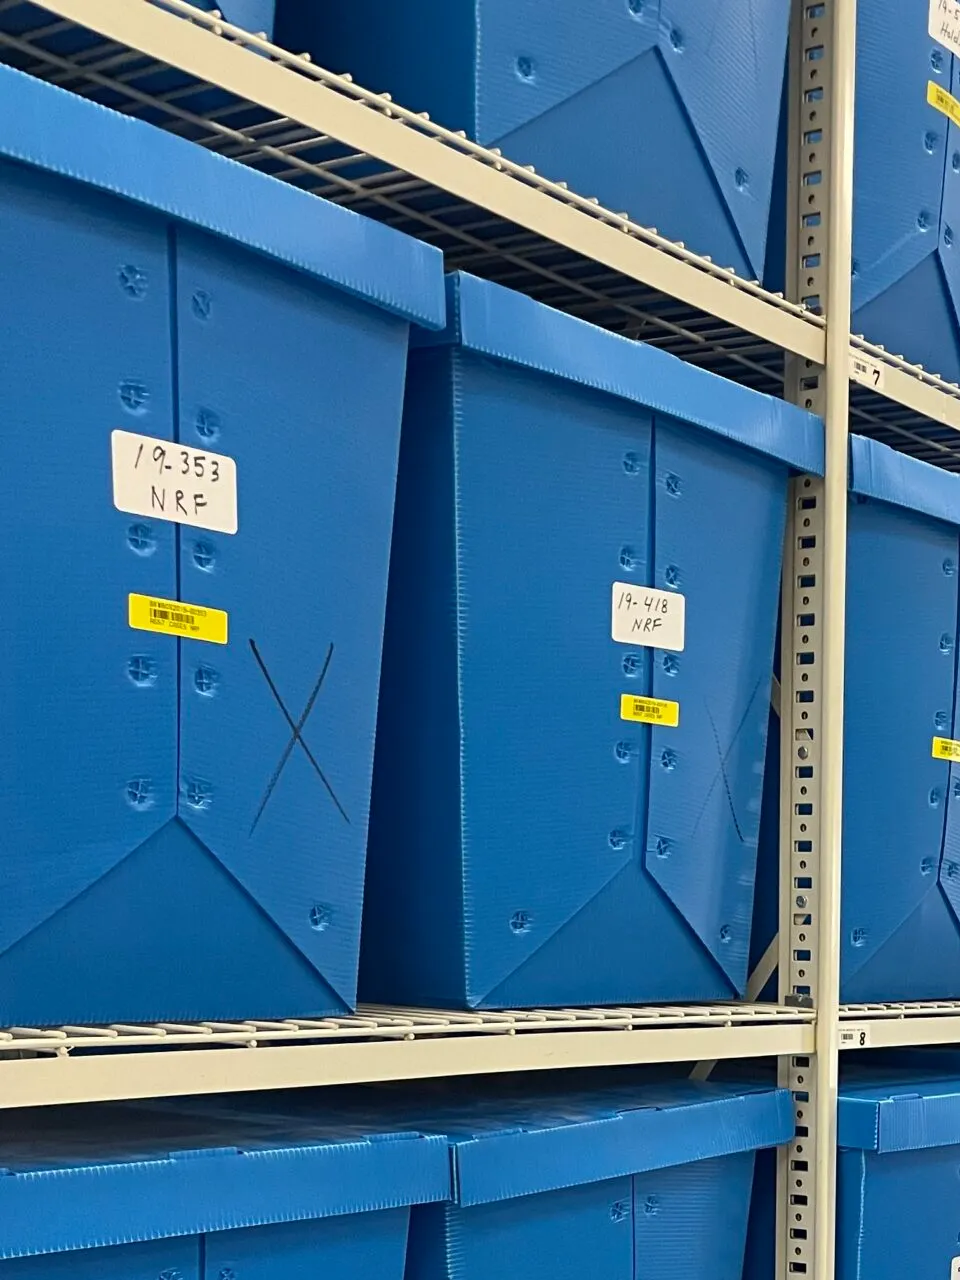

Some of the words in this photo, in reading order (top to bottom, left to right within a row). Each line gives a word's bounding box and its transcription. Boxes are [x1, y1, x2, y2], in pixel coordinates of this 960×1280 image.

[872, 368, 881, 386] 7
[134, 443, 220, 483] 19-353
[151, 485, 208, 516] NRF
[618, 591, 668, 614] 19-418
[631, 617, 662, 633] NRF
[859, 1031, 866, 1046] 8
